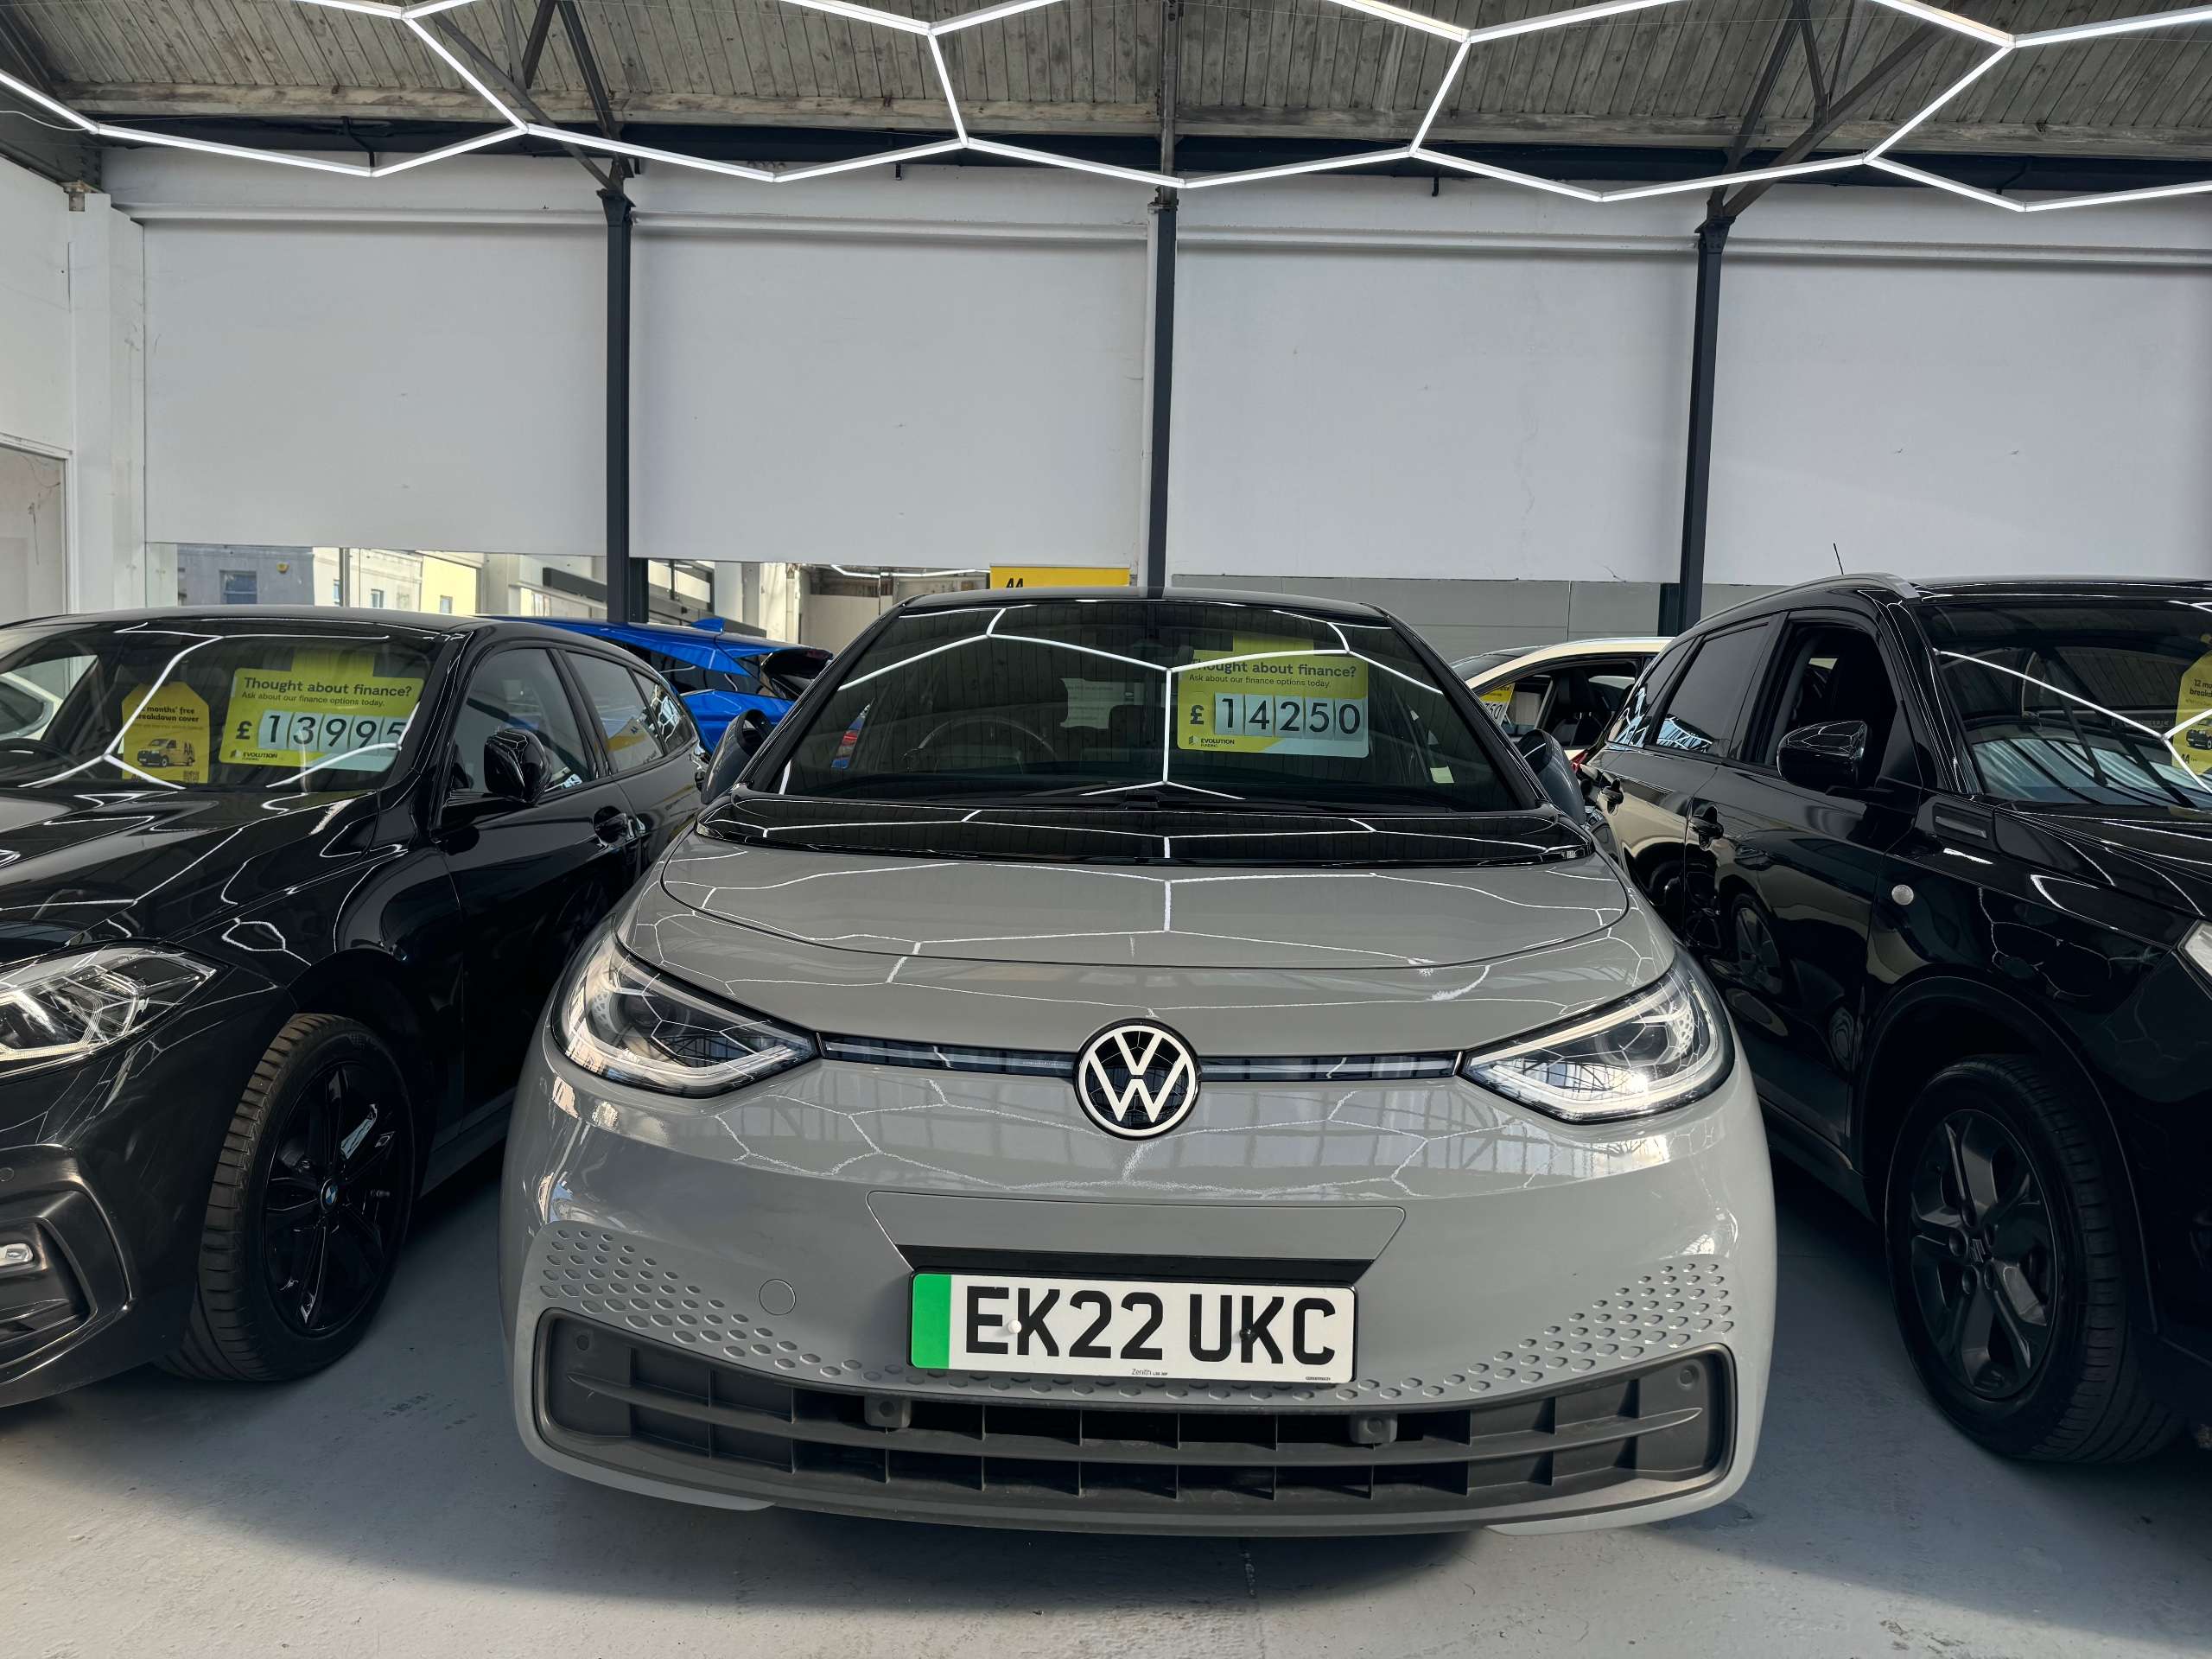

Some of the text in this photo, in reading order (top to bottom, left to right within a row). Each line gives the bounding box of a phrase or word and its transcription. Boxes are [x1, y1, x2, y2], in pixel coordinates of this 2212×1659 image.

[1189, 673, 1204, 682] Ask
[1205, 674, 1230, 683] about
[1252, 662, 1294, 675] about
[1298, 664, 1357, 678] finance?
[244, 677, 412, 696] Thought about finance?
[299, 695, 328, 703] finance
[330, 697, 359, 706] options
[1190, 698, 1361, 734] £ 14250
[235, 721, 252, 740] £
[965, 1285, 1336, 1366] EK22 UKC
[1131, 1368, 1152, 1376] Zenith
